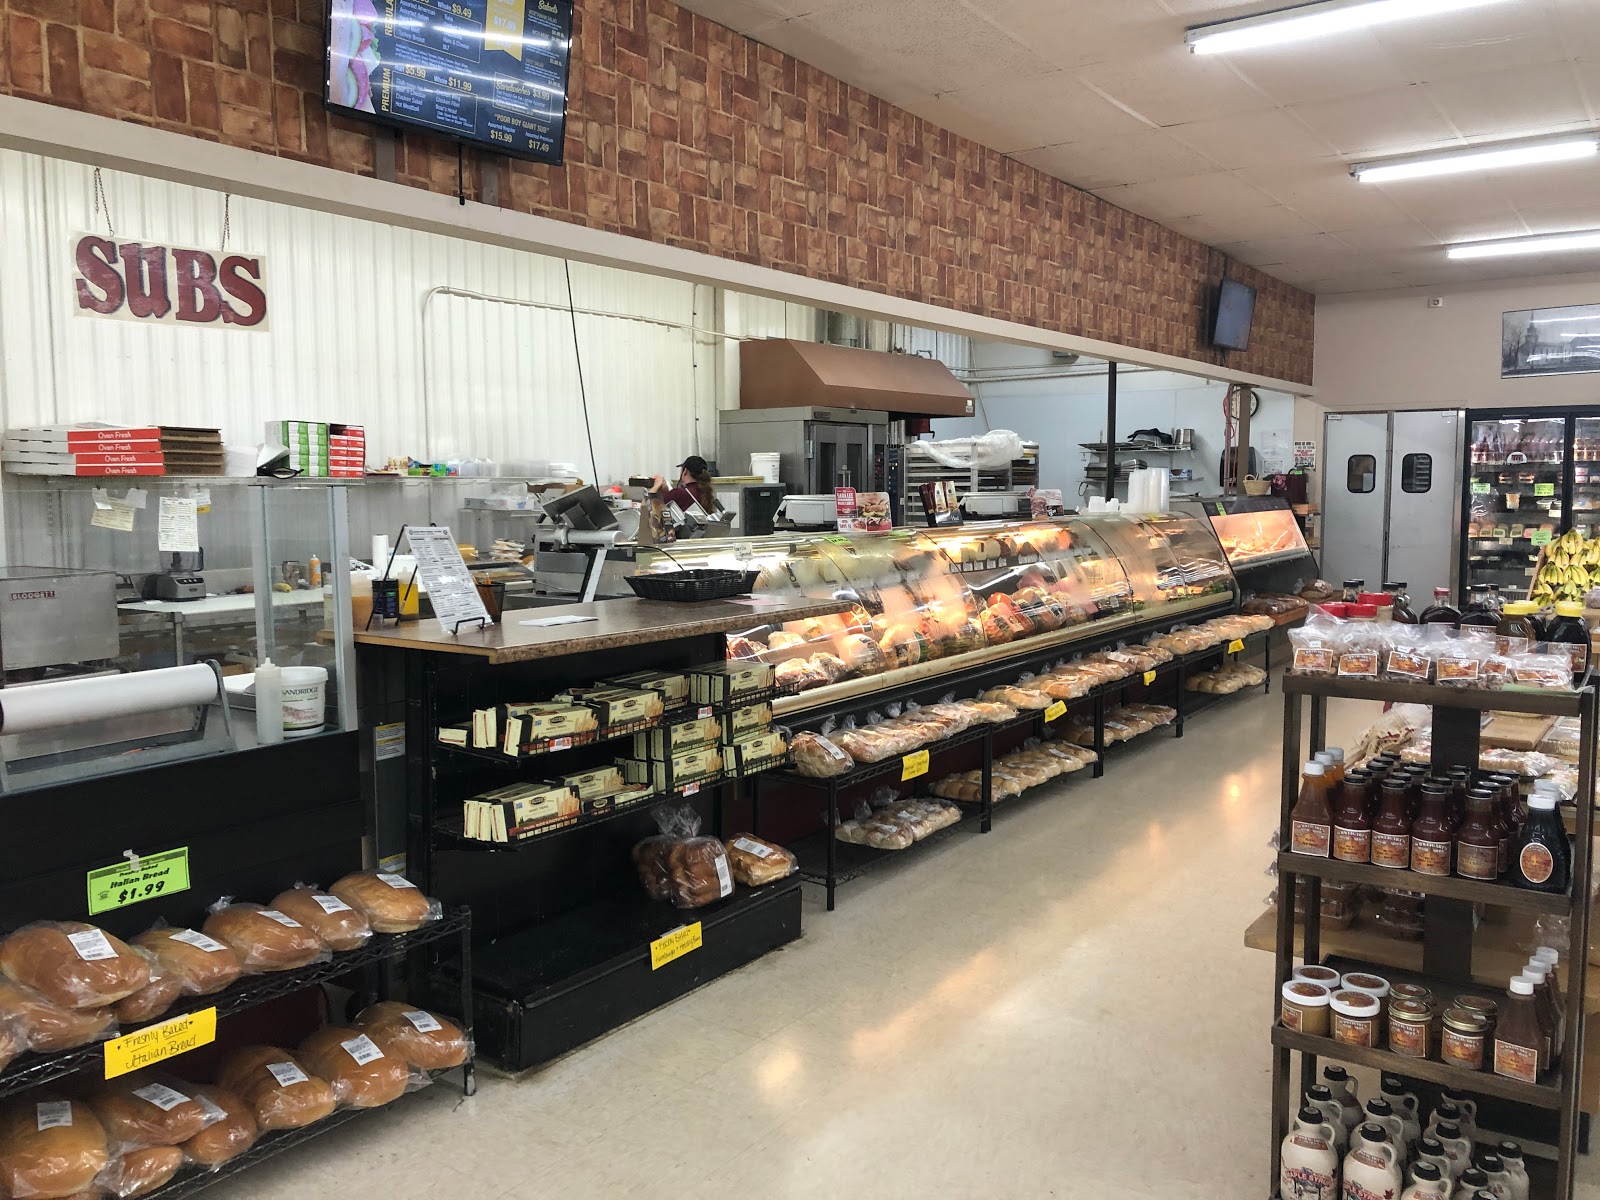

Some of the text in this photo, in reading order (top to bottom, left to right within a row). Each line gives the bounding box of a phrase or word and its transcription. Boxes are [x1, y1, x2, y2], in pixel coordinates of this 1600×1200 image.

[452, 3, 472, 18] $9.49
[405, 63, 426, 79] $5.99
[381, 67, 391, 112] PREMIUM
[448, 76, 472, 92] $11.99
[532, 88, 550, 101] $3.99
[490, 129, 513, 144] $15.99
[528, 139, 550, 153] $17.49
[75, 234, 268, 327] SUBS
[115, 431, 132, 439] Fresh
[115, 443, 132, 451] Fresh
[120, 454, 137, 462] Fresh
[121, 466, 137, 474] Fresh
[110, 867, 170, 889] Italian Bread
[117, 880, 166, 904] $1.99
[123, 1019, 189, 1049] Freshly Baked
[168, 1034, 198, 1056] Bread
